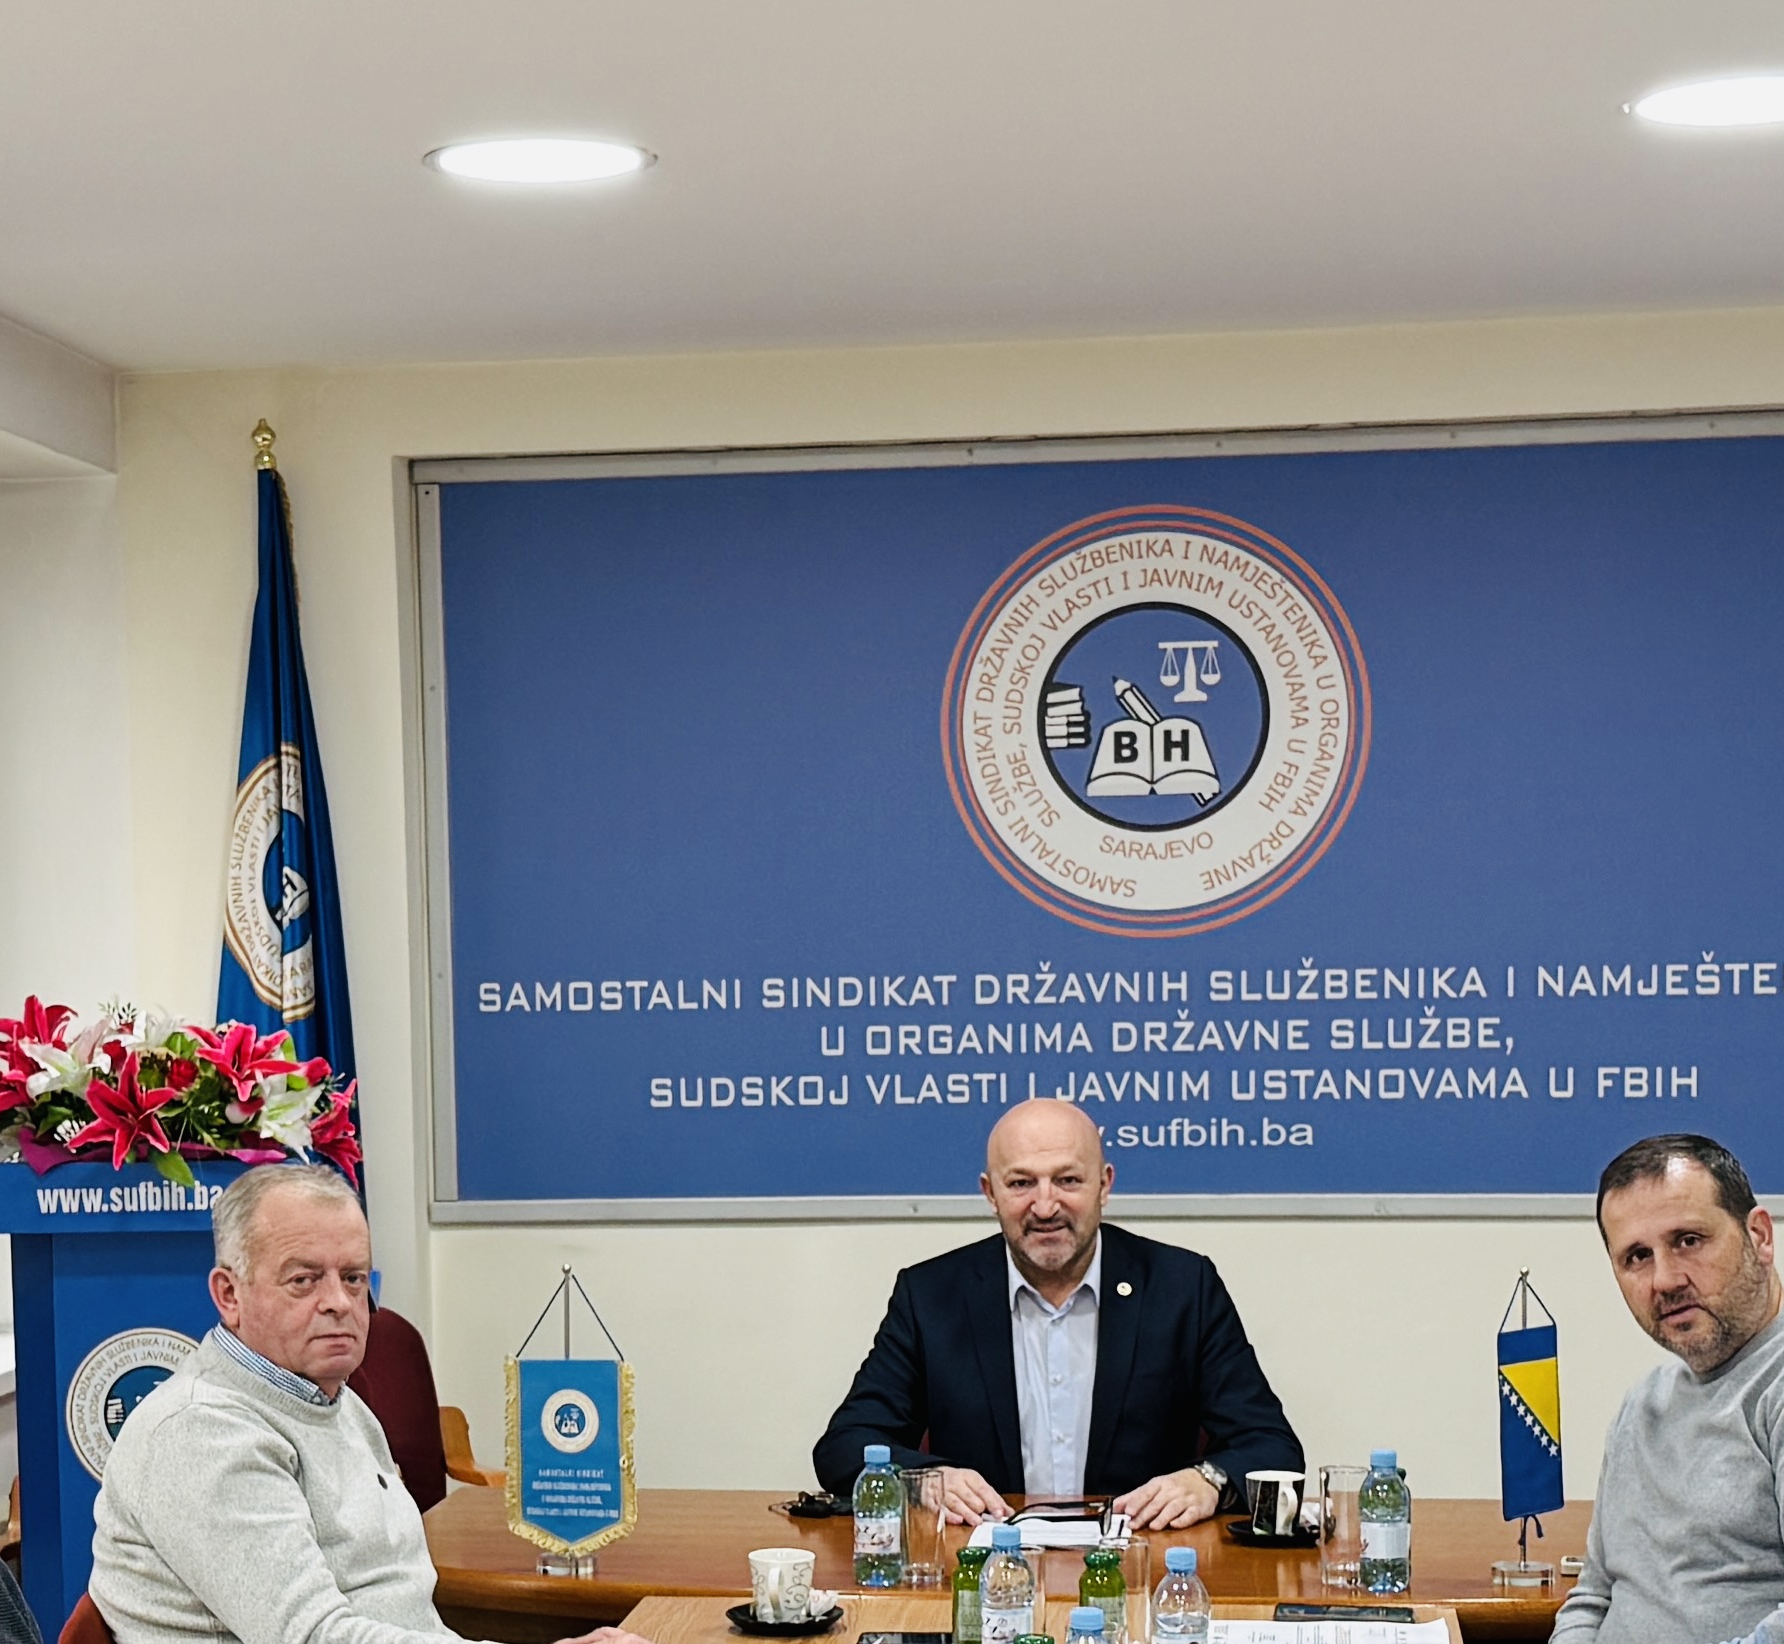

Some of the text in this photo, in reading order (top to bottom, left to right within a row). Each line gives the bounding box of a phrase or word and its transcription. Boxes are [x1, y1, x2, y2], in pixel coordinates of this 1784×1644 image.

[1121, 570, 1131, 592] I
[1139, 568, 1225, 600] JAVNIM
[1042, 576, 1115, 635] VLASTI
[1226, 588, 1311, 730] USTANOVAMA
[1002, 633, 1047, 736] SUDSKOJ
[973, 537, 1342, 898] SAMOSTALNI SINDIKAT DRŽAVNIH SLUŽBENIKA I NAMJEŠTENIKA U ORGANIMA DRŽAVNE
[1113, 728, 1191, 765] B H
[1286, 737, 1308, 756] U
[1258, 758, 1300, 814] FBIH
[1098, 831, 1214, 861] SARAJEVO
[478, 978, 741, 1013] SAMOSTALNI
[761, 974, 958, 1009] SINDIKAT
[974, 960, 1188, 1005] DRŽAVNIH
[1209, 956, 1488, 1002] SLUŽBENIKA
[1506, 966, 1515, 999] I
[821, 1005, 1514, 1057] U ORGANIMA DRŽAVNE SLUŽBE,
[649, 1065, 1699, 1108] SUDSKOJ VLASTI I JAVNIM USTANOVAMA U FBIH
[1098, 1117, 1314, 1148] .sufbih.ba
[36, 1179, 224, 1215] www.sufbih.ba
